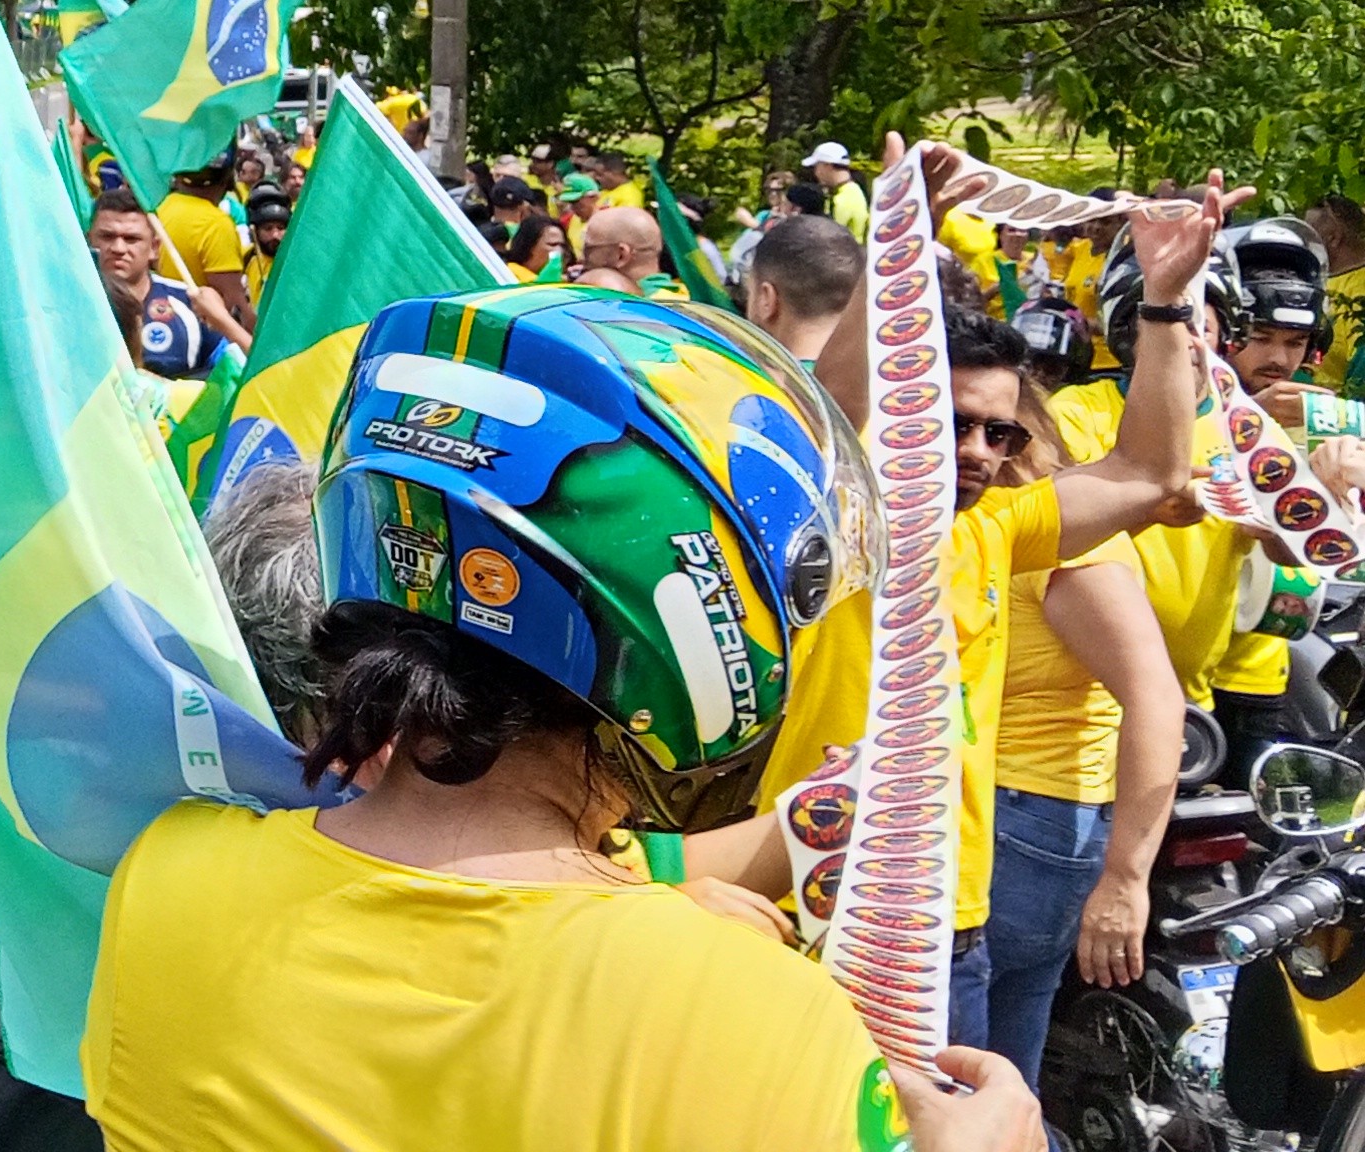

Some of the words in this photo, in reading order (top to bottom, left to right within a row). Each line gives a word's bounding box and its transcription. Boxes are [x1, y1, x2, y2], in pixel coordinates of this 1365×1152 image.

[366, 421, 414, 443] PRO
[416, 431, 498, 466] TORK
[390, 541, 435, 572] DOT
[670, 533, 759, 737] PATRIOTA
